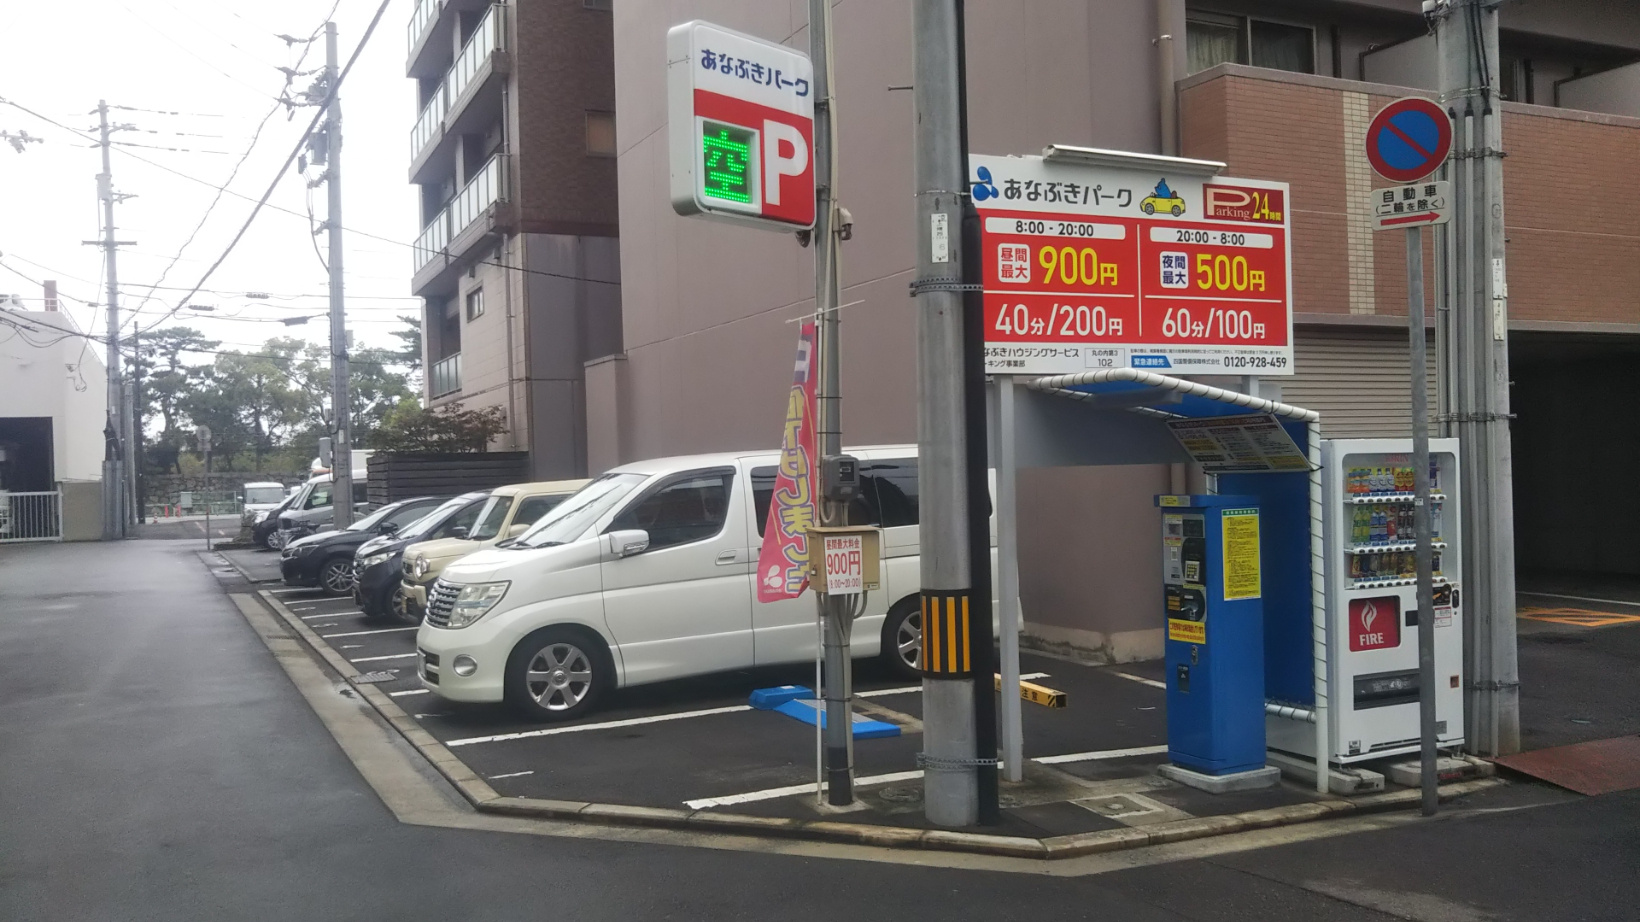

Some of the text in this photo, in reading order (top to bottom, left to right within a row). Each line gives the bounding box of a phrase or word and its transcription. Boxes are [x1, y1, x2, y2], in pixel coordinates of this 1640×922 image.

[701, 49, 809, 97] あなぶきパーク
[703, 130, 748, 203] 空
[763, 119, 809, 206] P
[1004, 178, 1133, 208] あなぶきパーク
[1206, 187, 1251, 220] Parking
[1382, 185, 1437, 203] 自動車
[1015, 220, 1045, 234] 8:00
[1058, 222, 1094, 237] 20:00
[1176, 230, 1209, 244] 20:00
[1220, 233, 1245, 246] 8:00
[1001, 247, 1028, 263] 昼間
[1039, 245, 1118, 286] 900円
[1162, 255, 1186, 270] 夜間
[1001, 264, 1028, 279] 最大
[1162, 271, 1186, 285] 最大
[1196, 253, 1265, 292] 500円
[995, 303, 1123, 337] 40分/200円
[1162, 308, 1265, 339] 60分/100円
[1097, 358, 1113, 367] 102
[1223, 356, 1287, 368] 0120-928-459
[826, 550, 861, 576] 900円
[1359, 632, 1385, 647] FIRE
